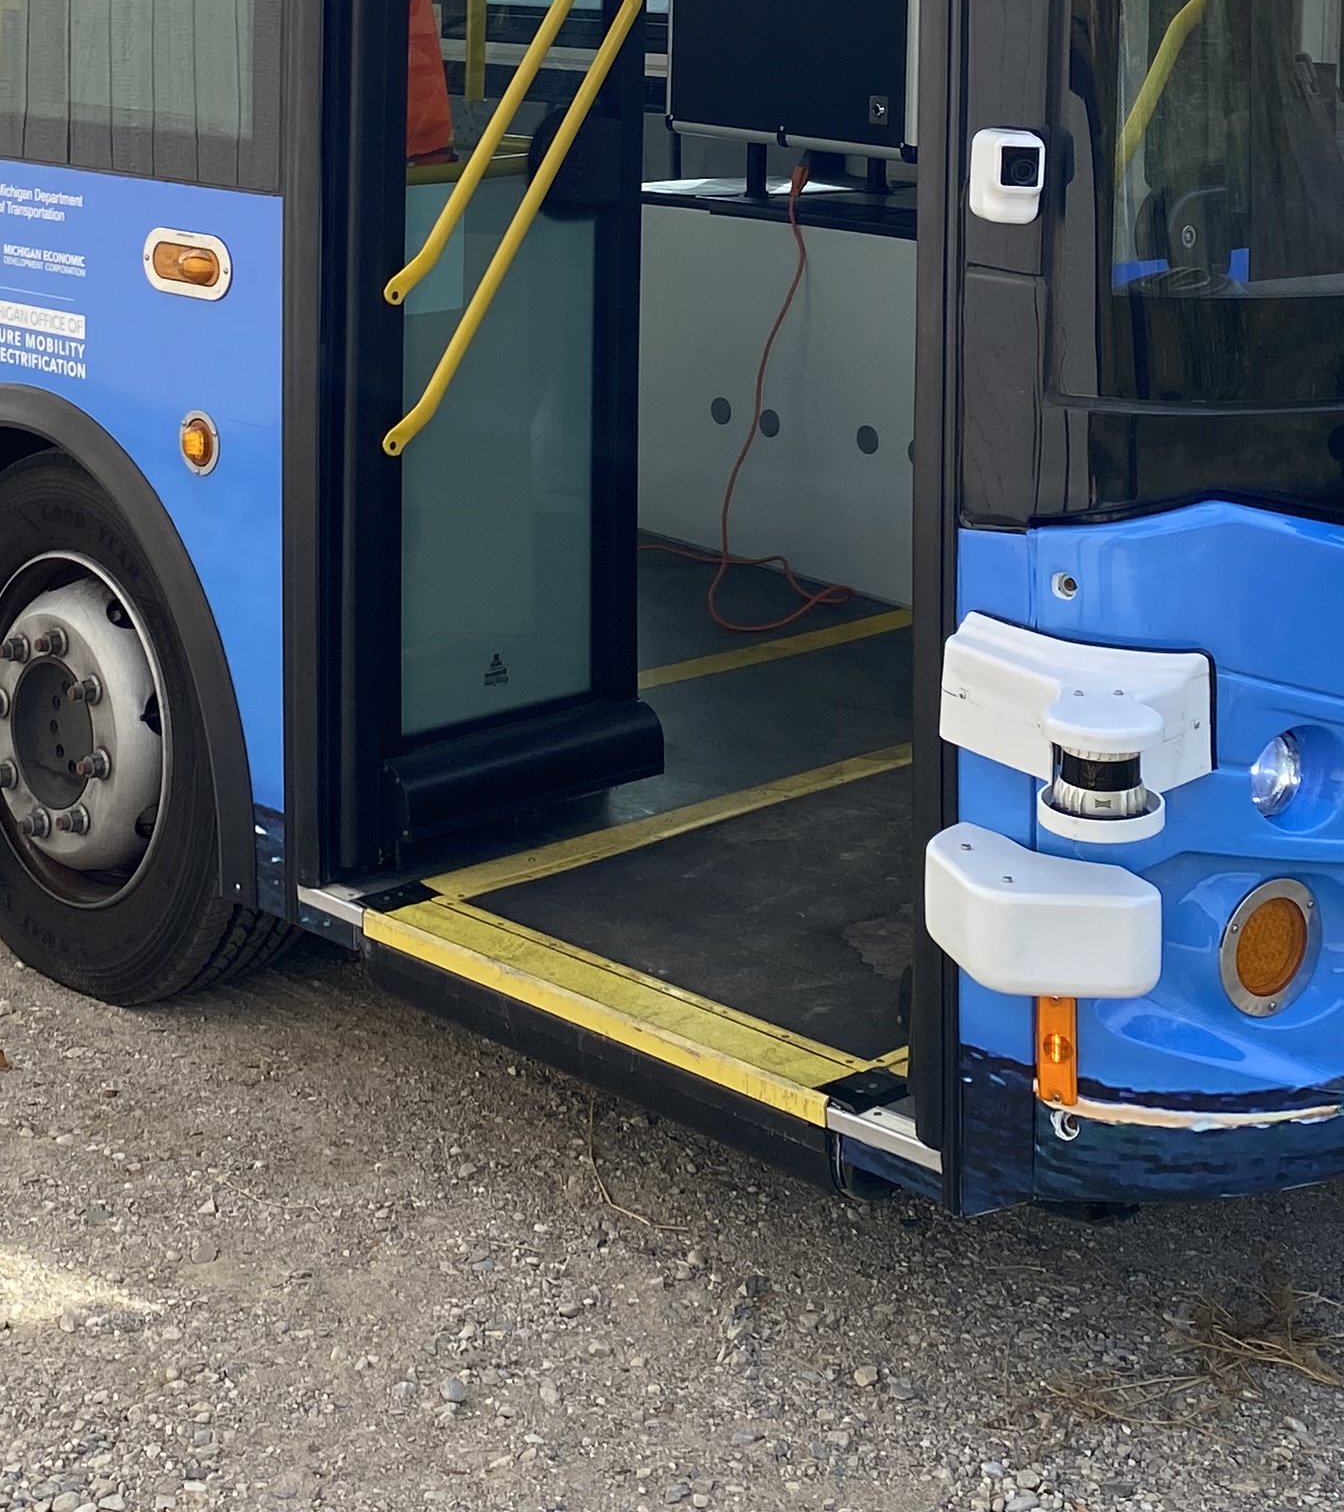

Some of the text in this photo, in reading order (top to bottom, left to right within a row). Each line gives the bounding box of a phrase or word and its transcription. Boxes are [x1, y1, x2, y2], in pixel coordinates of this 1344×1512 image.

[34, 188, 83, 207] Department
[6, 201, 65, 222] Transportation
[3, 244, 86, 268] MICHIGAN ECONOMIC
[3, 255, 86, 277] DEVELOPMENT CORPORATION
[30, 311, 66, 331] OFFICE
[68, 318, 83, 334] OF
[25, 333, 85, 359] MOBILITY
